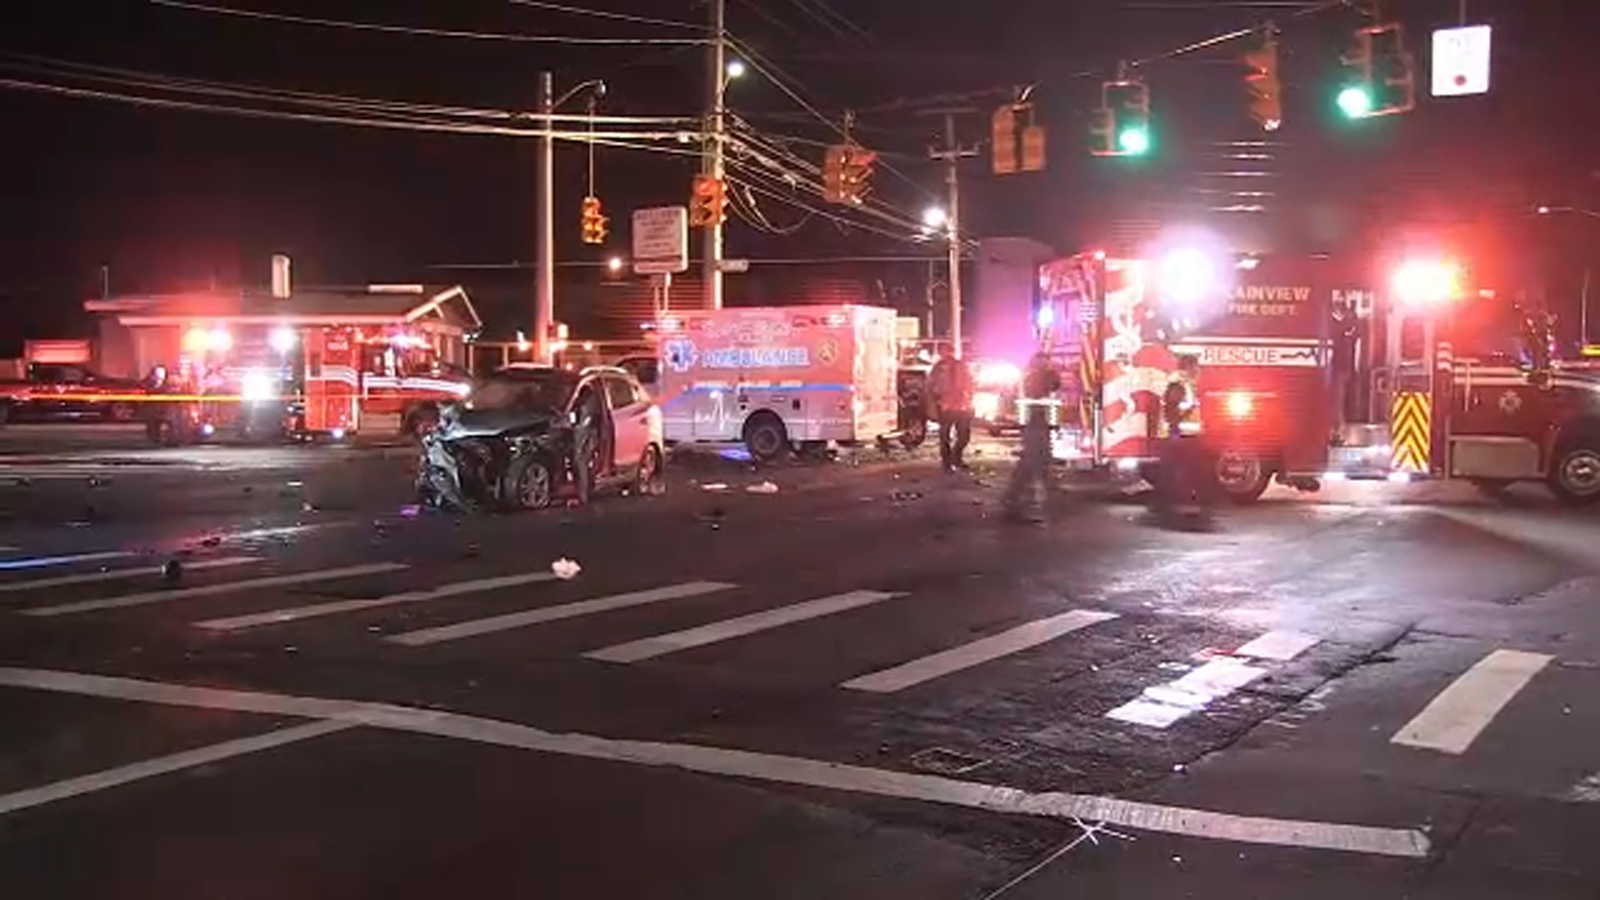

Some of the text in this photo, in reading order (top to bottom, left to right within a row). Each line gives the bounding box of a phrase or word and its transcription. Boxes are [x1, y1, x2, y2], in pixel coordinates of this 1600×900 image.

[1227, 286, 1312, 301] AINVIEW
[702, 348, 810, 366] AMBULANCE
[1204, 348, 1279, 363] RESCUE
